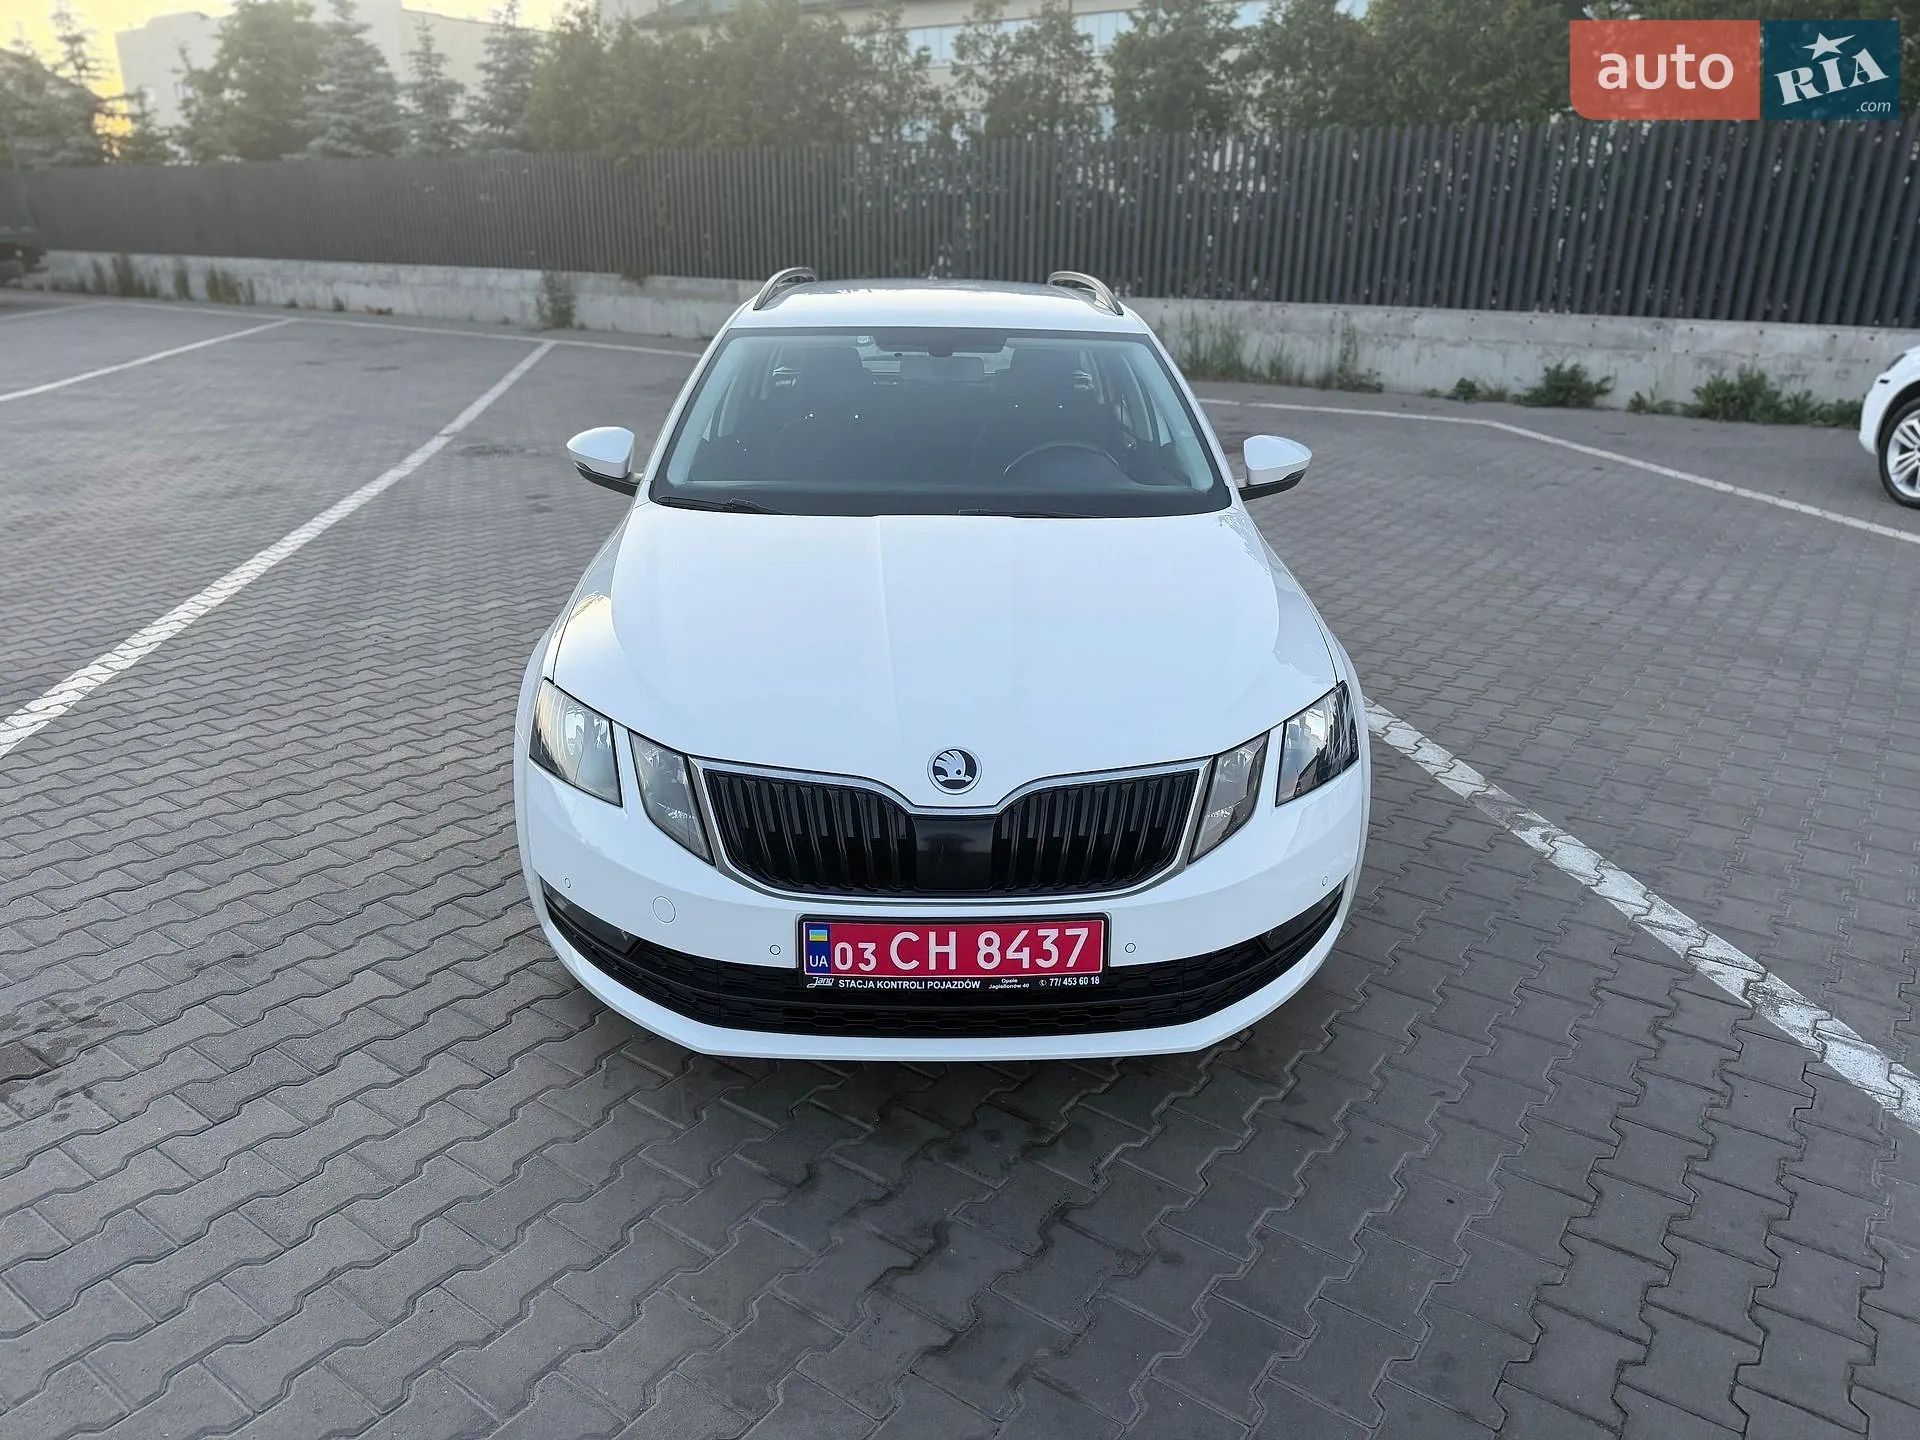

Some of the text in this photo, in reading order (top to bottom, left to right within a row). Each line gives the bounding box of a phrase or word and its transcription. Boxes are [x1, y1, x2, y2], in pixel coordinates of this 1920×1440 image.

[834, 927, 1089, 971] 03 CH 8437
[809, 955, 829, 968] UA
[838, 978, 981, 990] STACJA KONTROLI POJAZDÓW
[1049, 975, 1100, 987] 77/ 453 60 18
